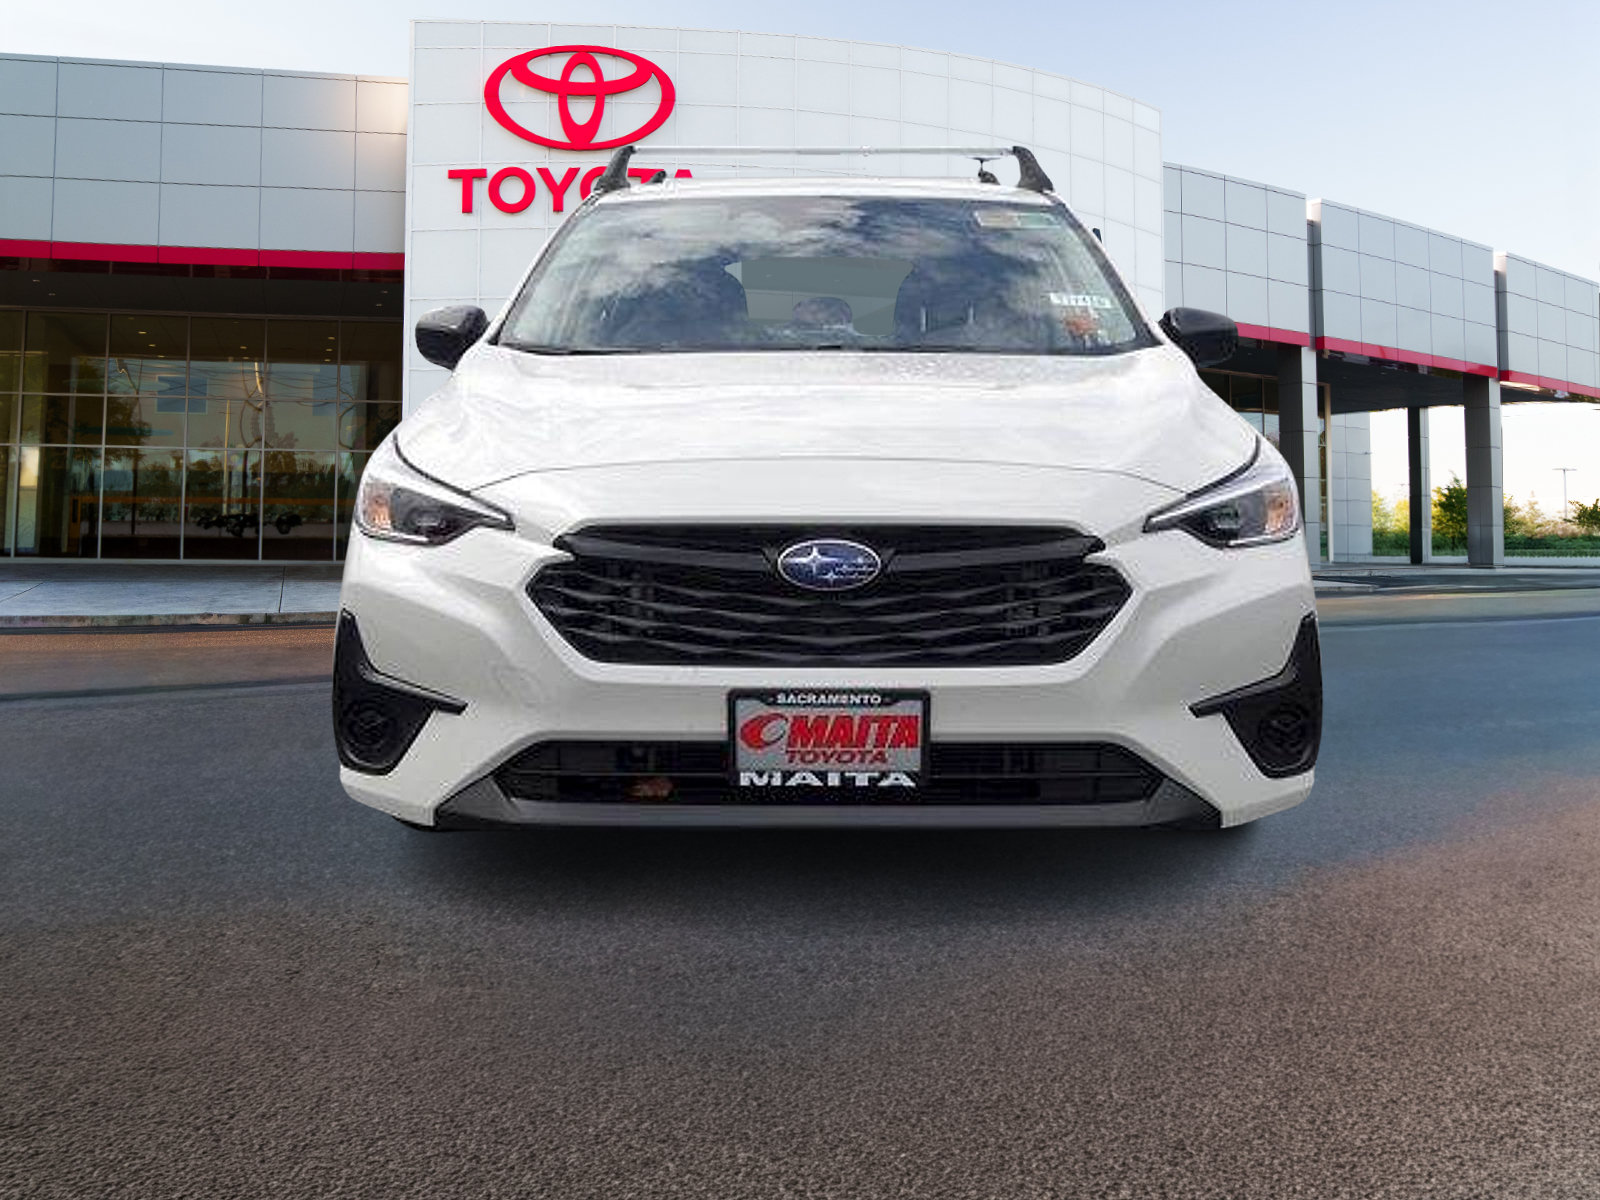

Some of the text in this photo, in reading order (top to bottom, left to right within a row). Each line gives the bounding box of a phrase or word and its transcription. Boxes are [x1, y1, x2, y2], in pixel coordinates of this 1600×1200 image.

[448, 166, 692, 213] TOY
[776, 692, 882, 704] SACRAMENTO
[786, 715, 919, 748] MAITA
[786, 750, 888, 763] TOYOTA
[738, 772, 916, 787] MAITA
